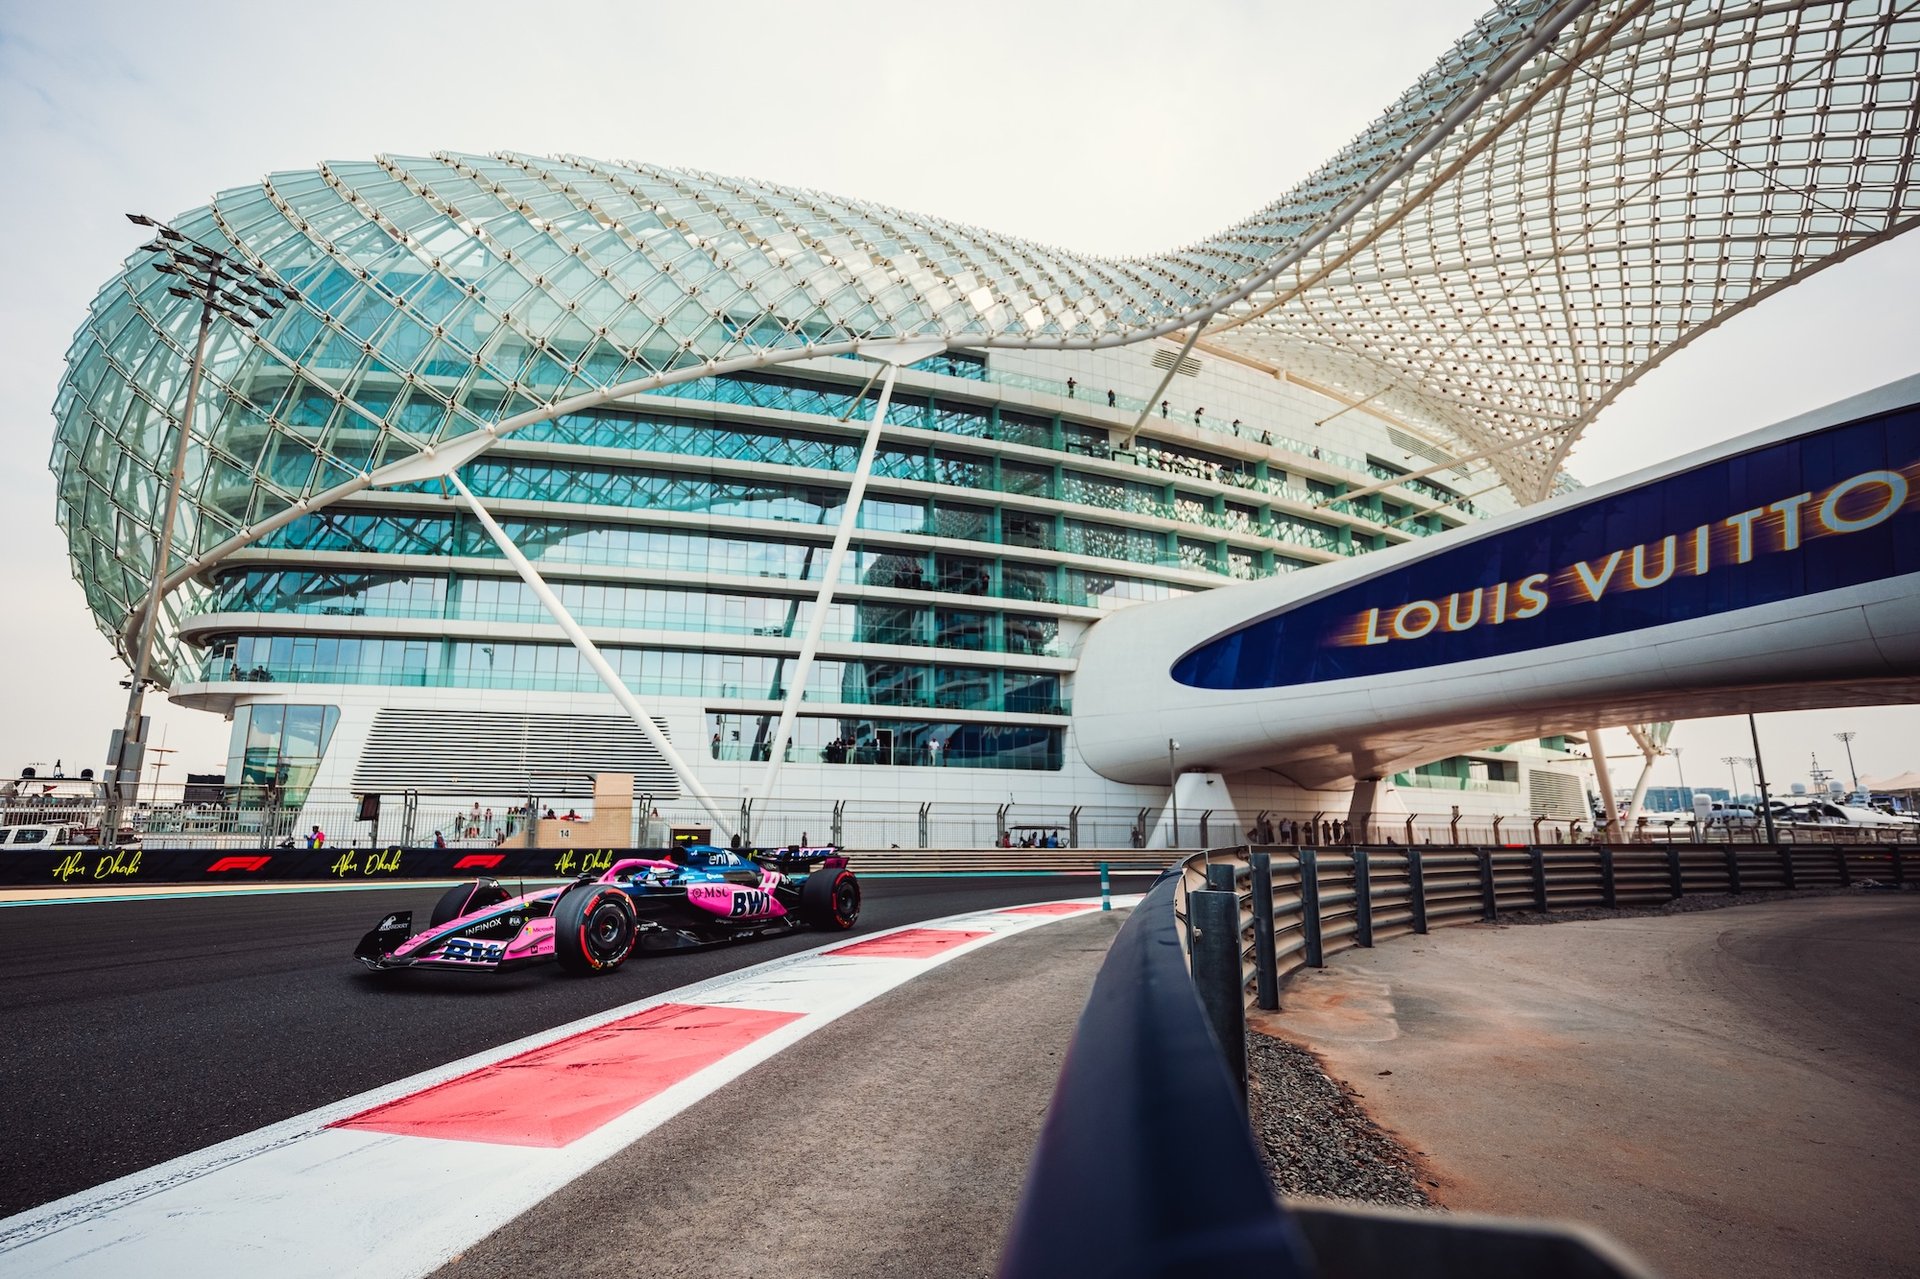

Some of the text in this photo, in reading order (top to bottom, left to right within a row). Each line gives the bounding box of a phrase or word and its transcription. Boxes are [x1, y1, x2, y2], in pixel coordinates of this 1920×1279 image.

[1365, 470, 1909, 646] LOUIS VUITTO
[560, 829, 570, 838] 14
[52, 850, 143, 882] Abu Dhabi
[331, 849, 402, 878] Abu Dhabi
[554, 849, 614, 875] Abu Dhabi
[704, 886, 730, 898] MSC
[465, 917, 502, 937] INFINOX
